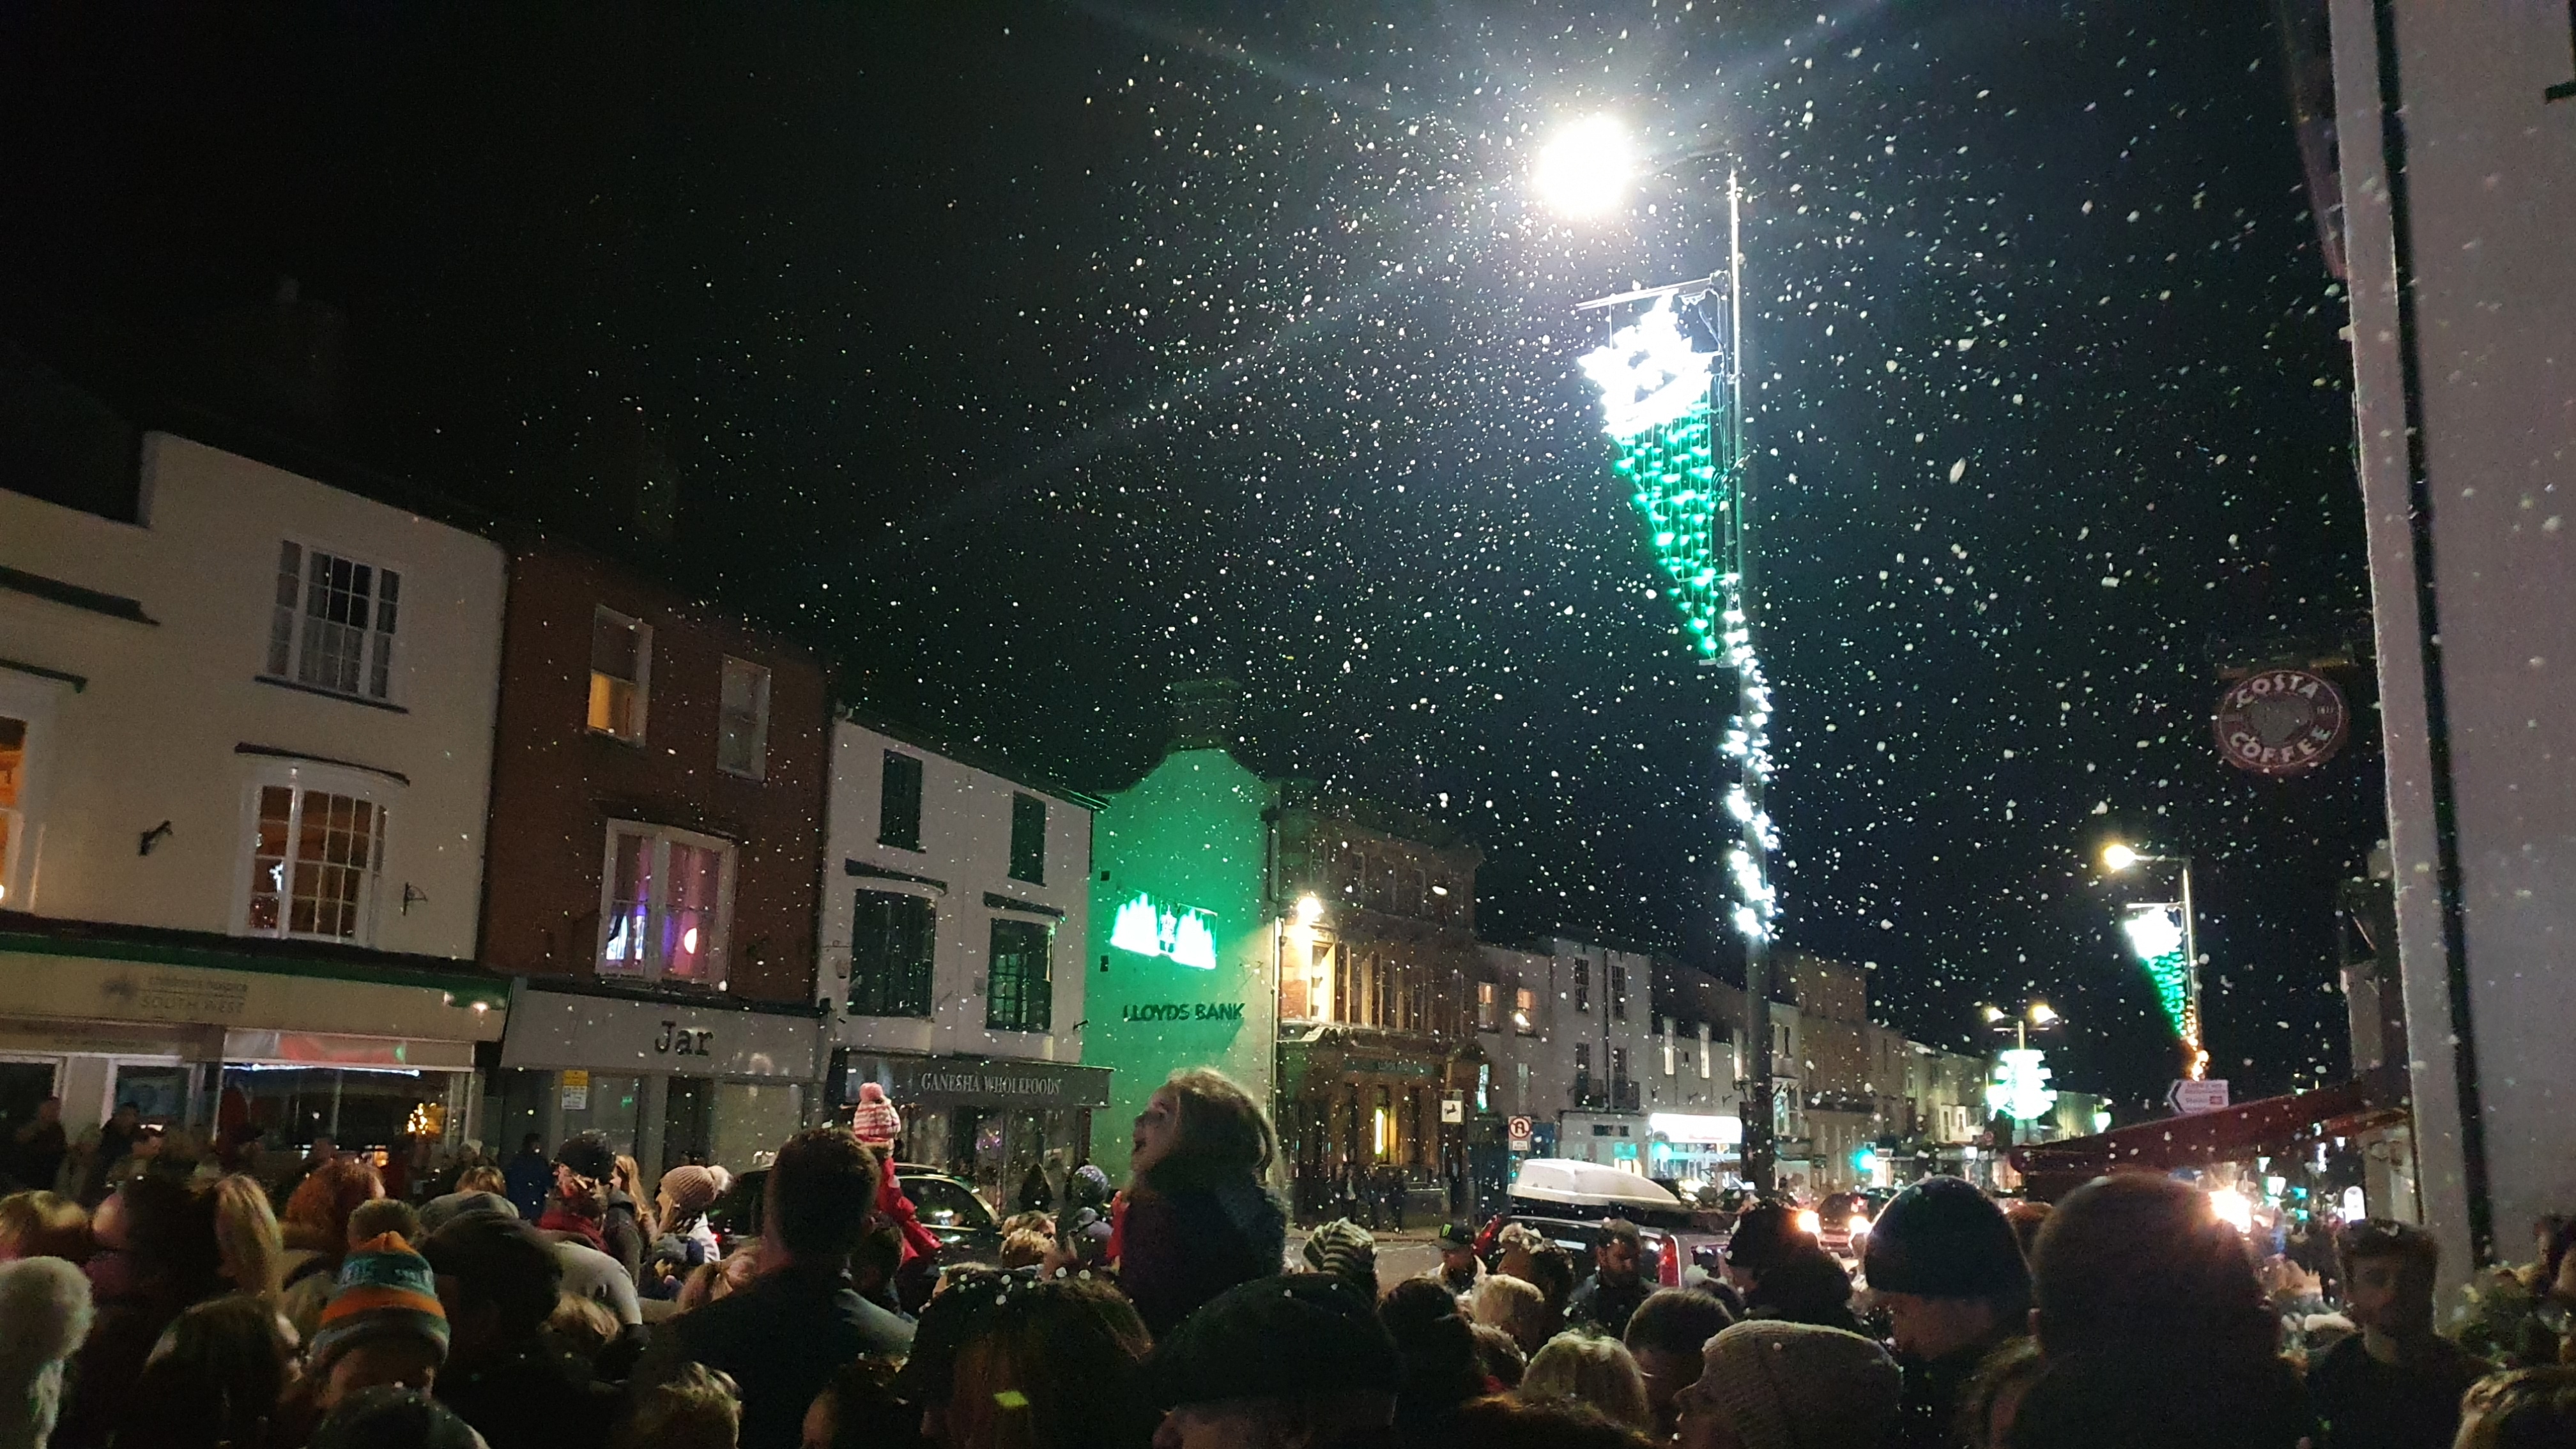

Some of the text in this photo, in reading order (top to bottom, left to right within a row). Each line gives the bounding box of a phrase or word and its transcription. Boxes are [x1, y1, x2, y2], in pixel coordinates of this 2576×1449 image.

[2236, 673, 2319, 706] COSTA
[2229, 724, 2332, 763] COFFEE
[1123, 1002, 1246, 1022] LLOYDS BANK
[655, 1021, 714, 1056] Jar
[921, 1073, 1061, 1095] GANESHA WHOLEFOODS
